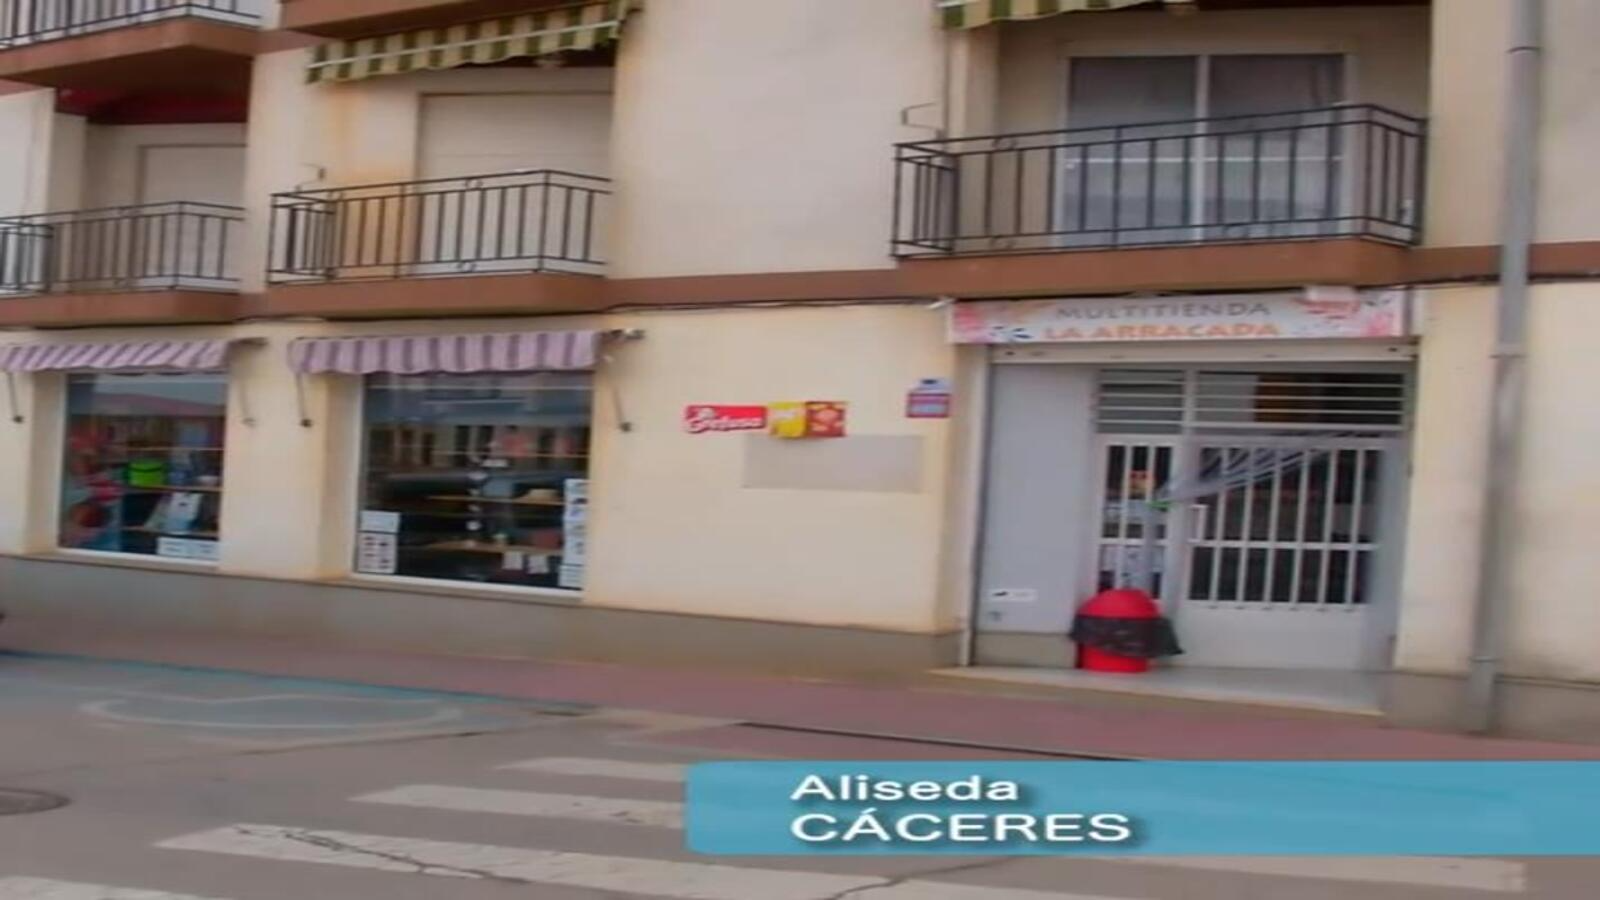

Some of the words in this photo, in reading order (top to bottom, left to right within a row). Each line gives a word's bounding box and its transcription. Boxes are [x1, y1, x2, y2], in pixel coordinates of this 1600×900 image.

[1056, 303, 1272, 319] MULTITIENDA
[1044, 326, 1086, 339] LA
[1094, 323, 1280, 338] ARRACADA
